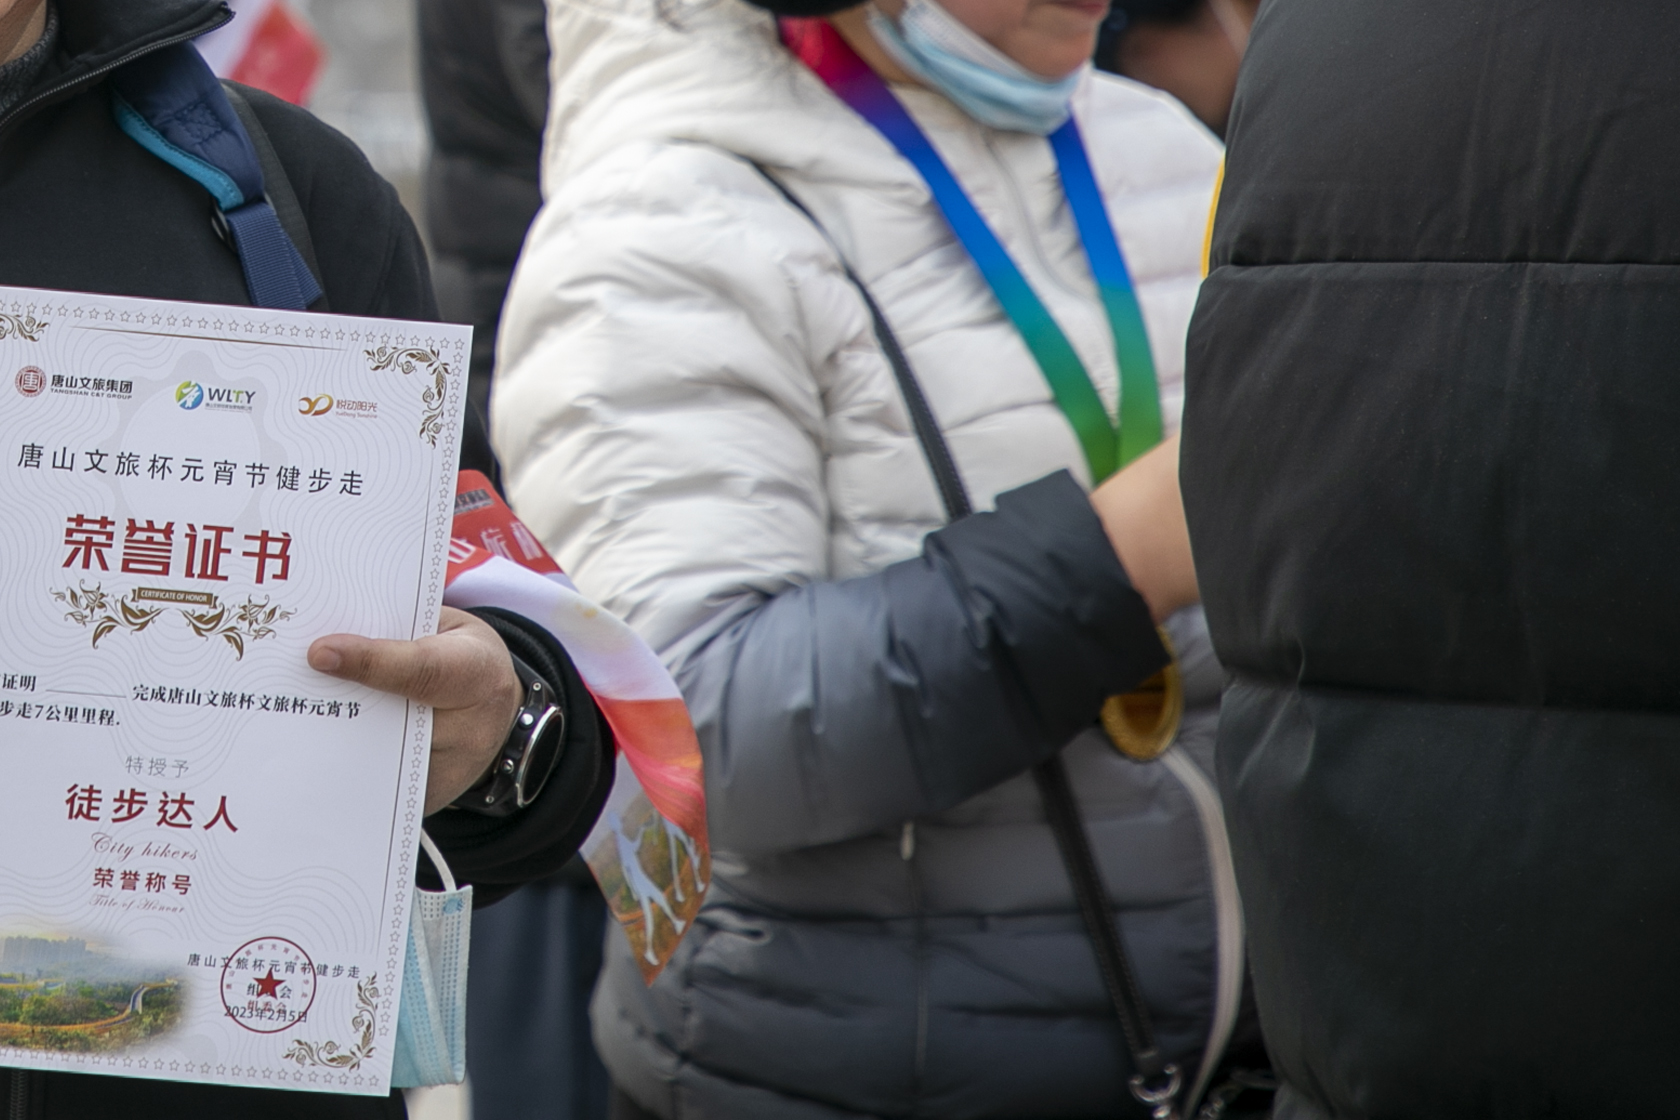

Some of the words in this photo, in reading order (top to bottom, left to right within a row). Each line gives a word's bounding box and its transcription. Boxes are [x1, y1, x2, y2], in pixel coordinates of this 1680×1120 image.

[50, 388, 89, 396] TANGSHAN
[51, 374, 133, 394] 唐山文旅集团
[335, 399, 378, 413] 悦动阳光
[17, 442, 365, 497] 唐山文旅杯元宵节健步走
[62, 513, 293, 585] 荣誉证书
[140, 590, 176, 600] CERTIFICATE
[185, 594, 208, 602] HONOR
[132, 683, 362, 719] 完成唐山文旅杯文旅杯元宵节
[125, 755, 189, 779] 特授予
[64, 783, 239, 834] 徒步达人
[91, 832, 135, 862] City
[141, 841, 199, 861] hikers
[92, 867, 192, 895] 荣誉称号
[122, 899, 136, 911] of
[187, 953, 361, 979] 唐山文旅杯元宵节健步走
[246, 982, 293, 1000] 组会
[224, 1005, 308, 1023] 2023年2月5日
